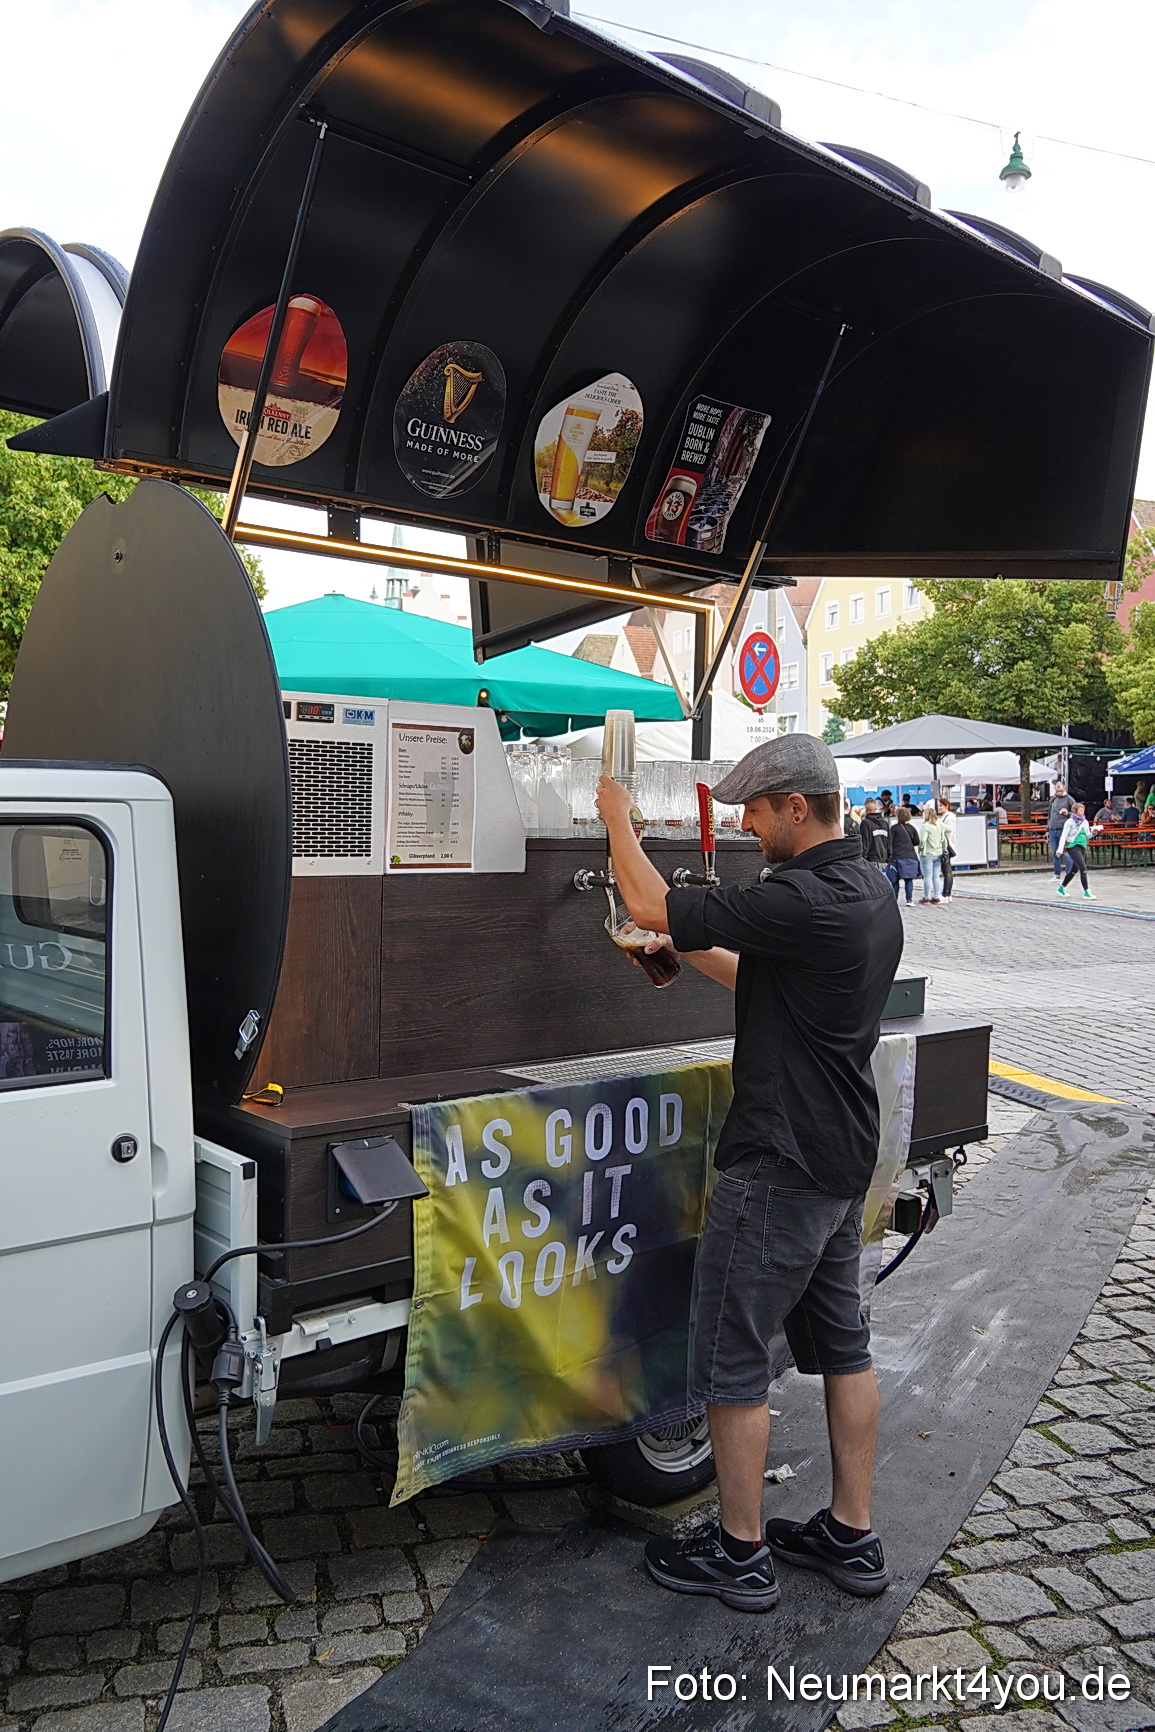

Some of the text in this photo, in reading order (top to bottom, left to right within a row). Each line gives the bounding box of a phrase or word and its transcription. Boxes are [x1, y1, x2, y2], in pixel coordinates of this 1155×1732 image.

[264, 408, 291, 420] KILKENNY
[692, 410, 721, 426] MORE TASTE
[695, 402, 710, 414] MORE
[235, 408, 265, 430] IRIH
[267, 416, 289, 435] RED
[291, 422, 312, 440] ALE
[407, 417, 486, 451] GUINNESS
[687, 422, 716, 441] DUBLIN
[406, 440, 481, 464] MADE OF MORE
[684, 436, 710, 454] BORN &
[680, 449, 707, 465] BREWED
[666, 500, 682, 513] 13
[398, 733, 448, 744] Unsere Preise:
[707, 794, 715, 836] KILKENNY
[445, 1092, 685, 1187] AS GOOD
[481, 1163, 633, 1249] AS IT
[458, 1222, 638, 1311] LOOKS
[441, 1443, 467, 1457] GUINNESS
[466, 1433, 502, 1448] RESPONSIBLY.
